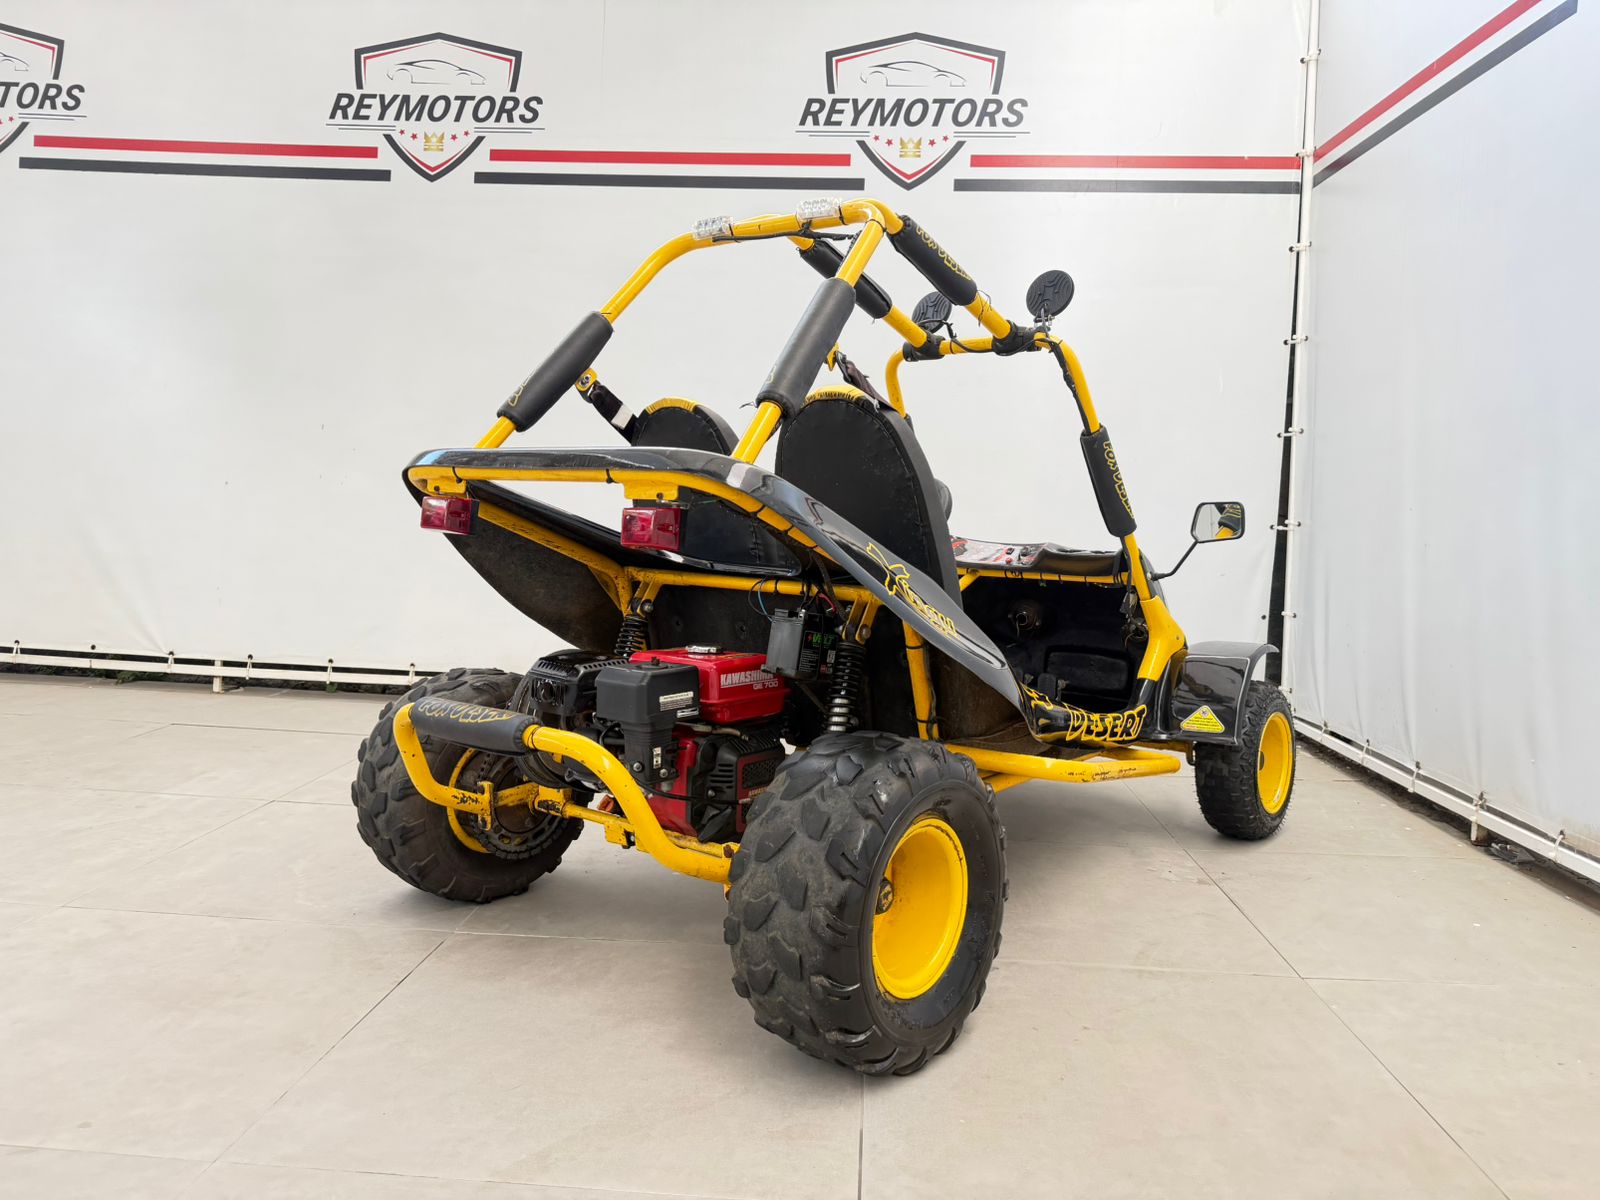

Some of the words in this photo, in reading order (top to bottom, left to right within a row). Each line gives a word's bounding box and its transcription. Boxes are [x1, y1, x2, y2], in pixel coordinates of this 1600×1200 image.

[329, 93, 543, 124] REYMOTORS
[799, 97, 1028, 128] REYMOTORS
[764, 680, 779, 688] 700
[1066, 704, 1147, 741] DESERT
